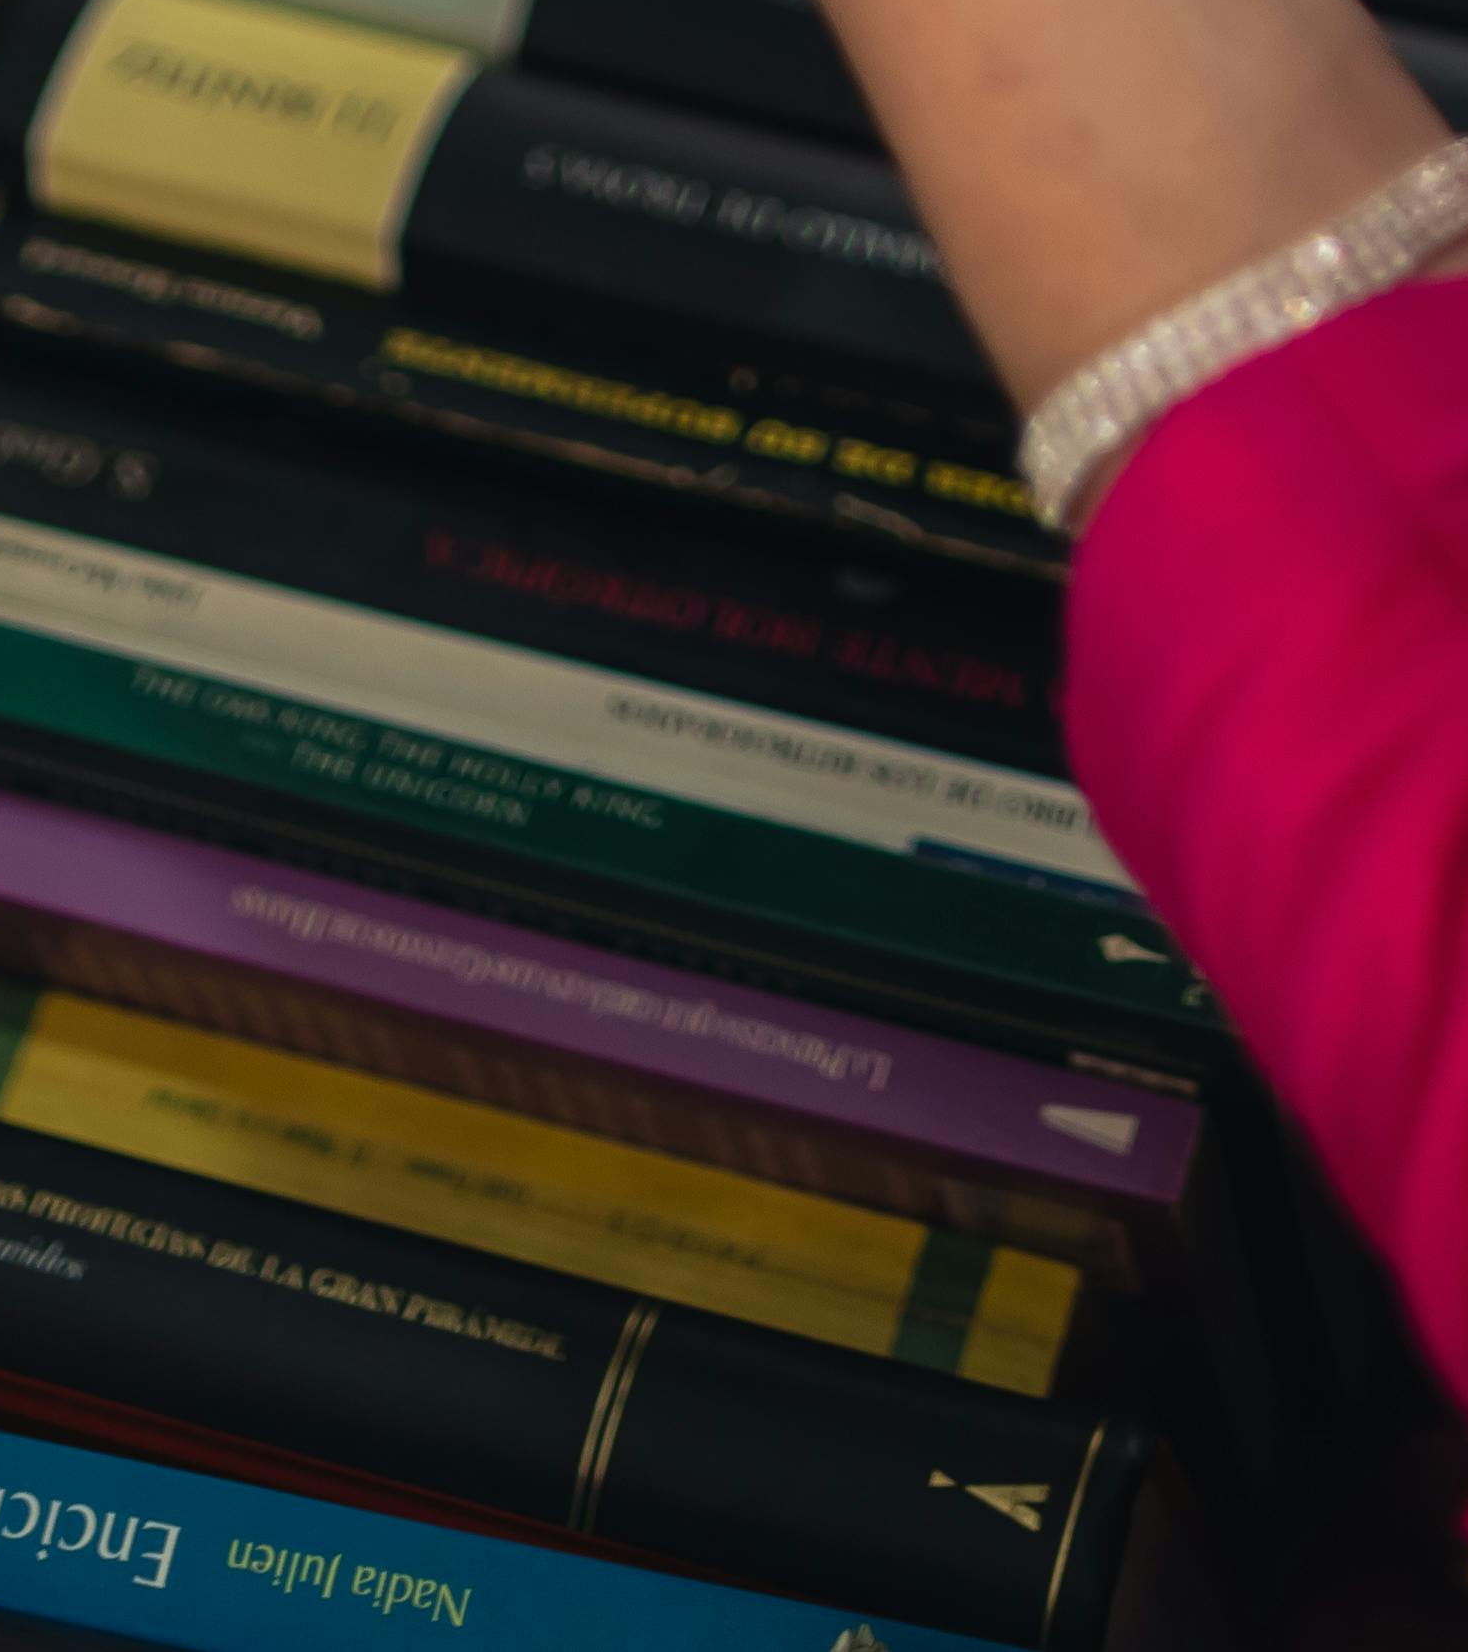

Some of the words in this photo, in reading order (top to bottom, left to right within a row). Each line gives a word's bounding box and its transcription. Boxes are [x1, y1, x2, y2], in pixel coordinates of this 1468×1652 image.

[207, 1239, 260, 1279] DE
[260, 1254, 306, 1292] LA
[307, 1265, 406, 1320] GRAN
[222, 1531, 342, 1598] Julien
[349, 1558, 473, 1628] Nadia
